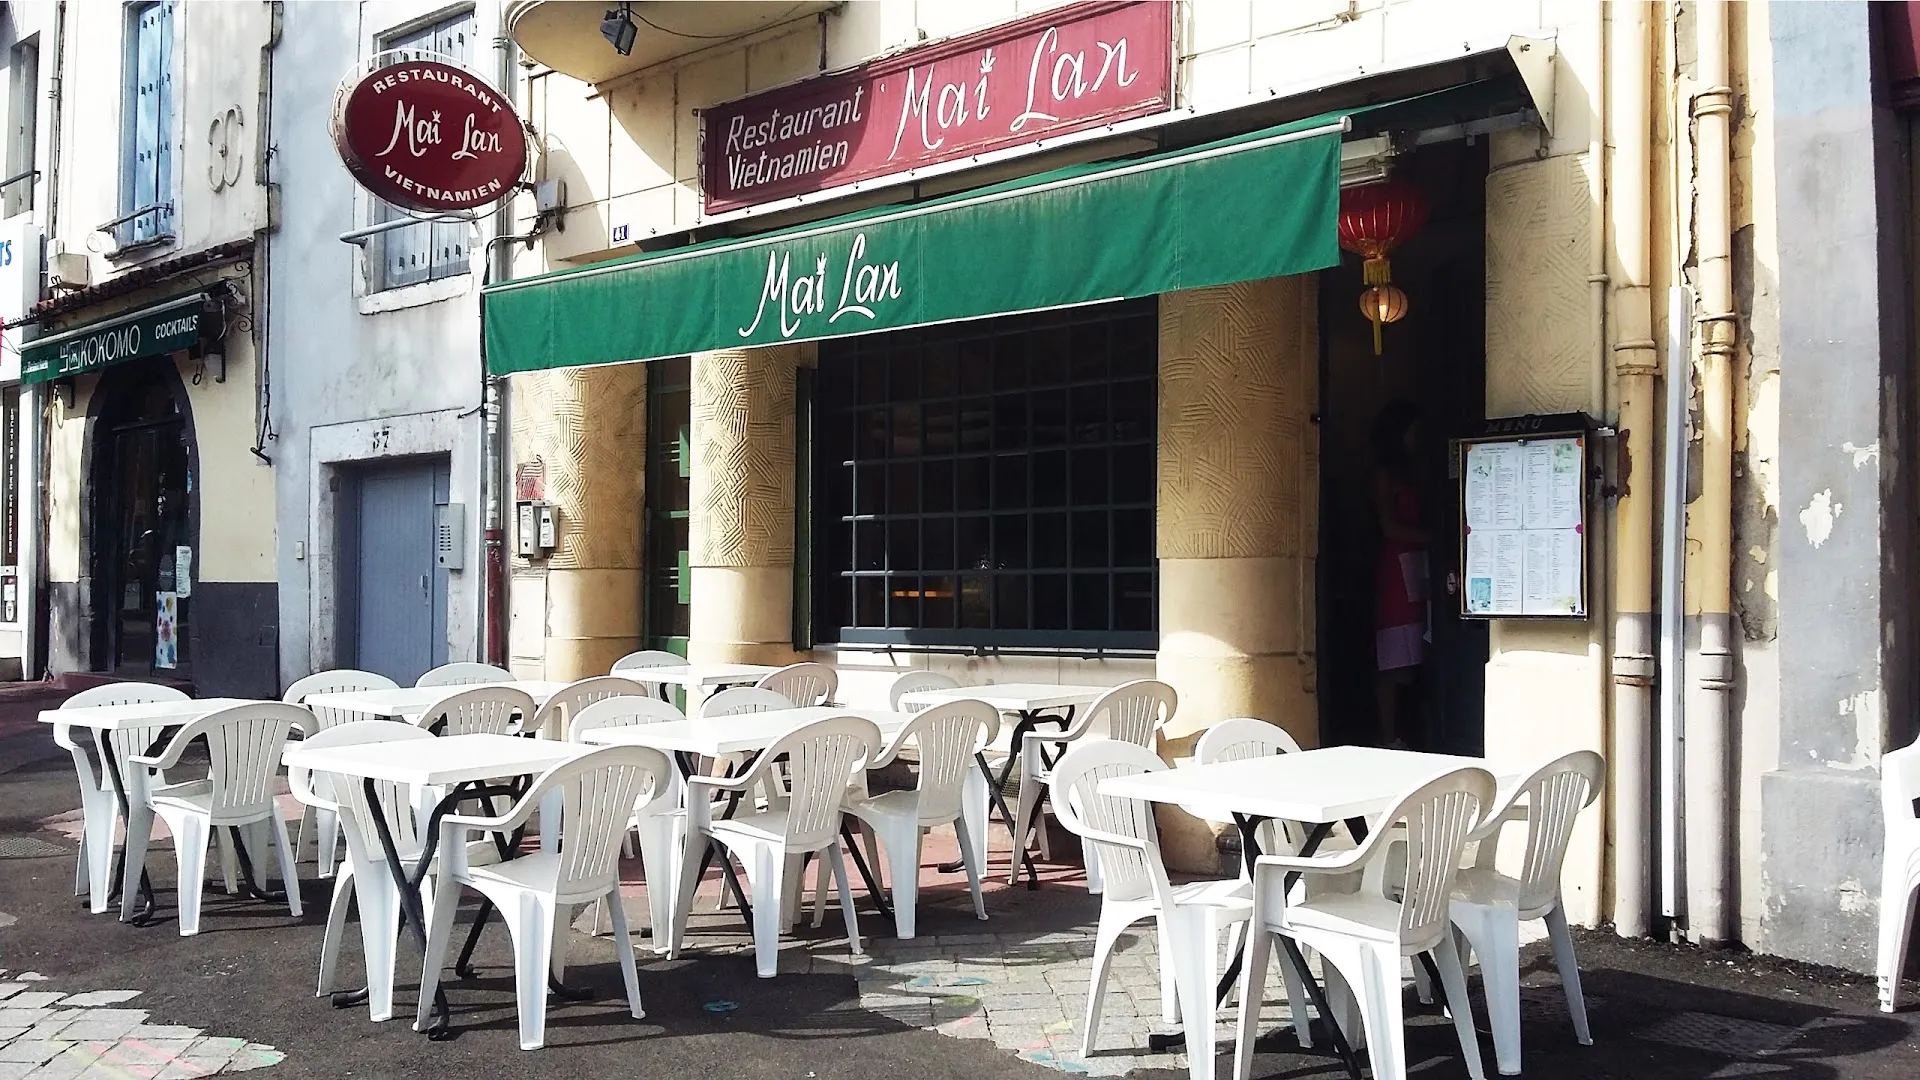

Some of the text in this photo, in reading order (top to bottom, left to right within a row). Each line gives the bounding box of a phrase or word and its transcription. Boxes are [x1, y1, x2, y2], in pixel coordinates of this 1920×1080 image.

[372, 69, 501, 113] RESTAURANT
[887, 26, 1139, 161] Mai Lan
[375, 99, 503, 160] Mai Lan
[726, 86, 864, 155] Restaurant
[385, 165, 502, 202] VIETNAMIEN
[728, 140, 849, 191] Vietnamien
[738, 233, 902, 338] Mai Lan
[80, 324, 141, 368] KOKOMO
[155, 314, 198, 340] COCKTAILS
[1484, 418, 1543, 433] MENU
